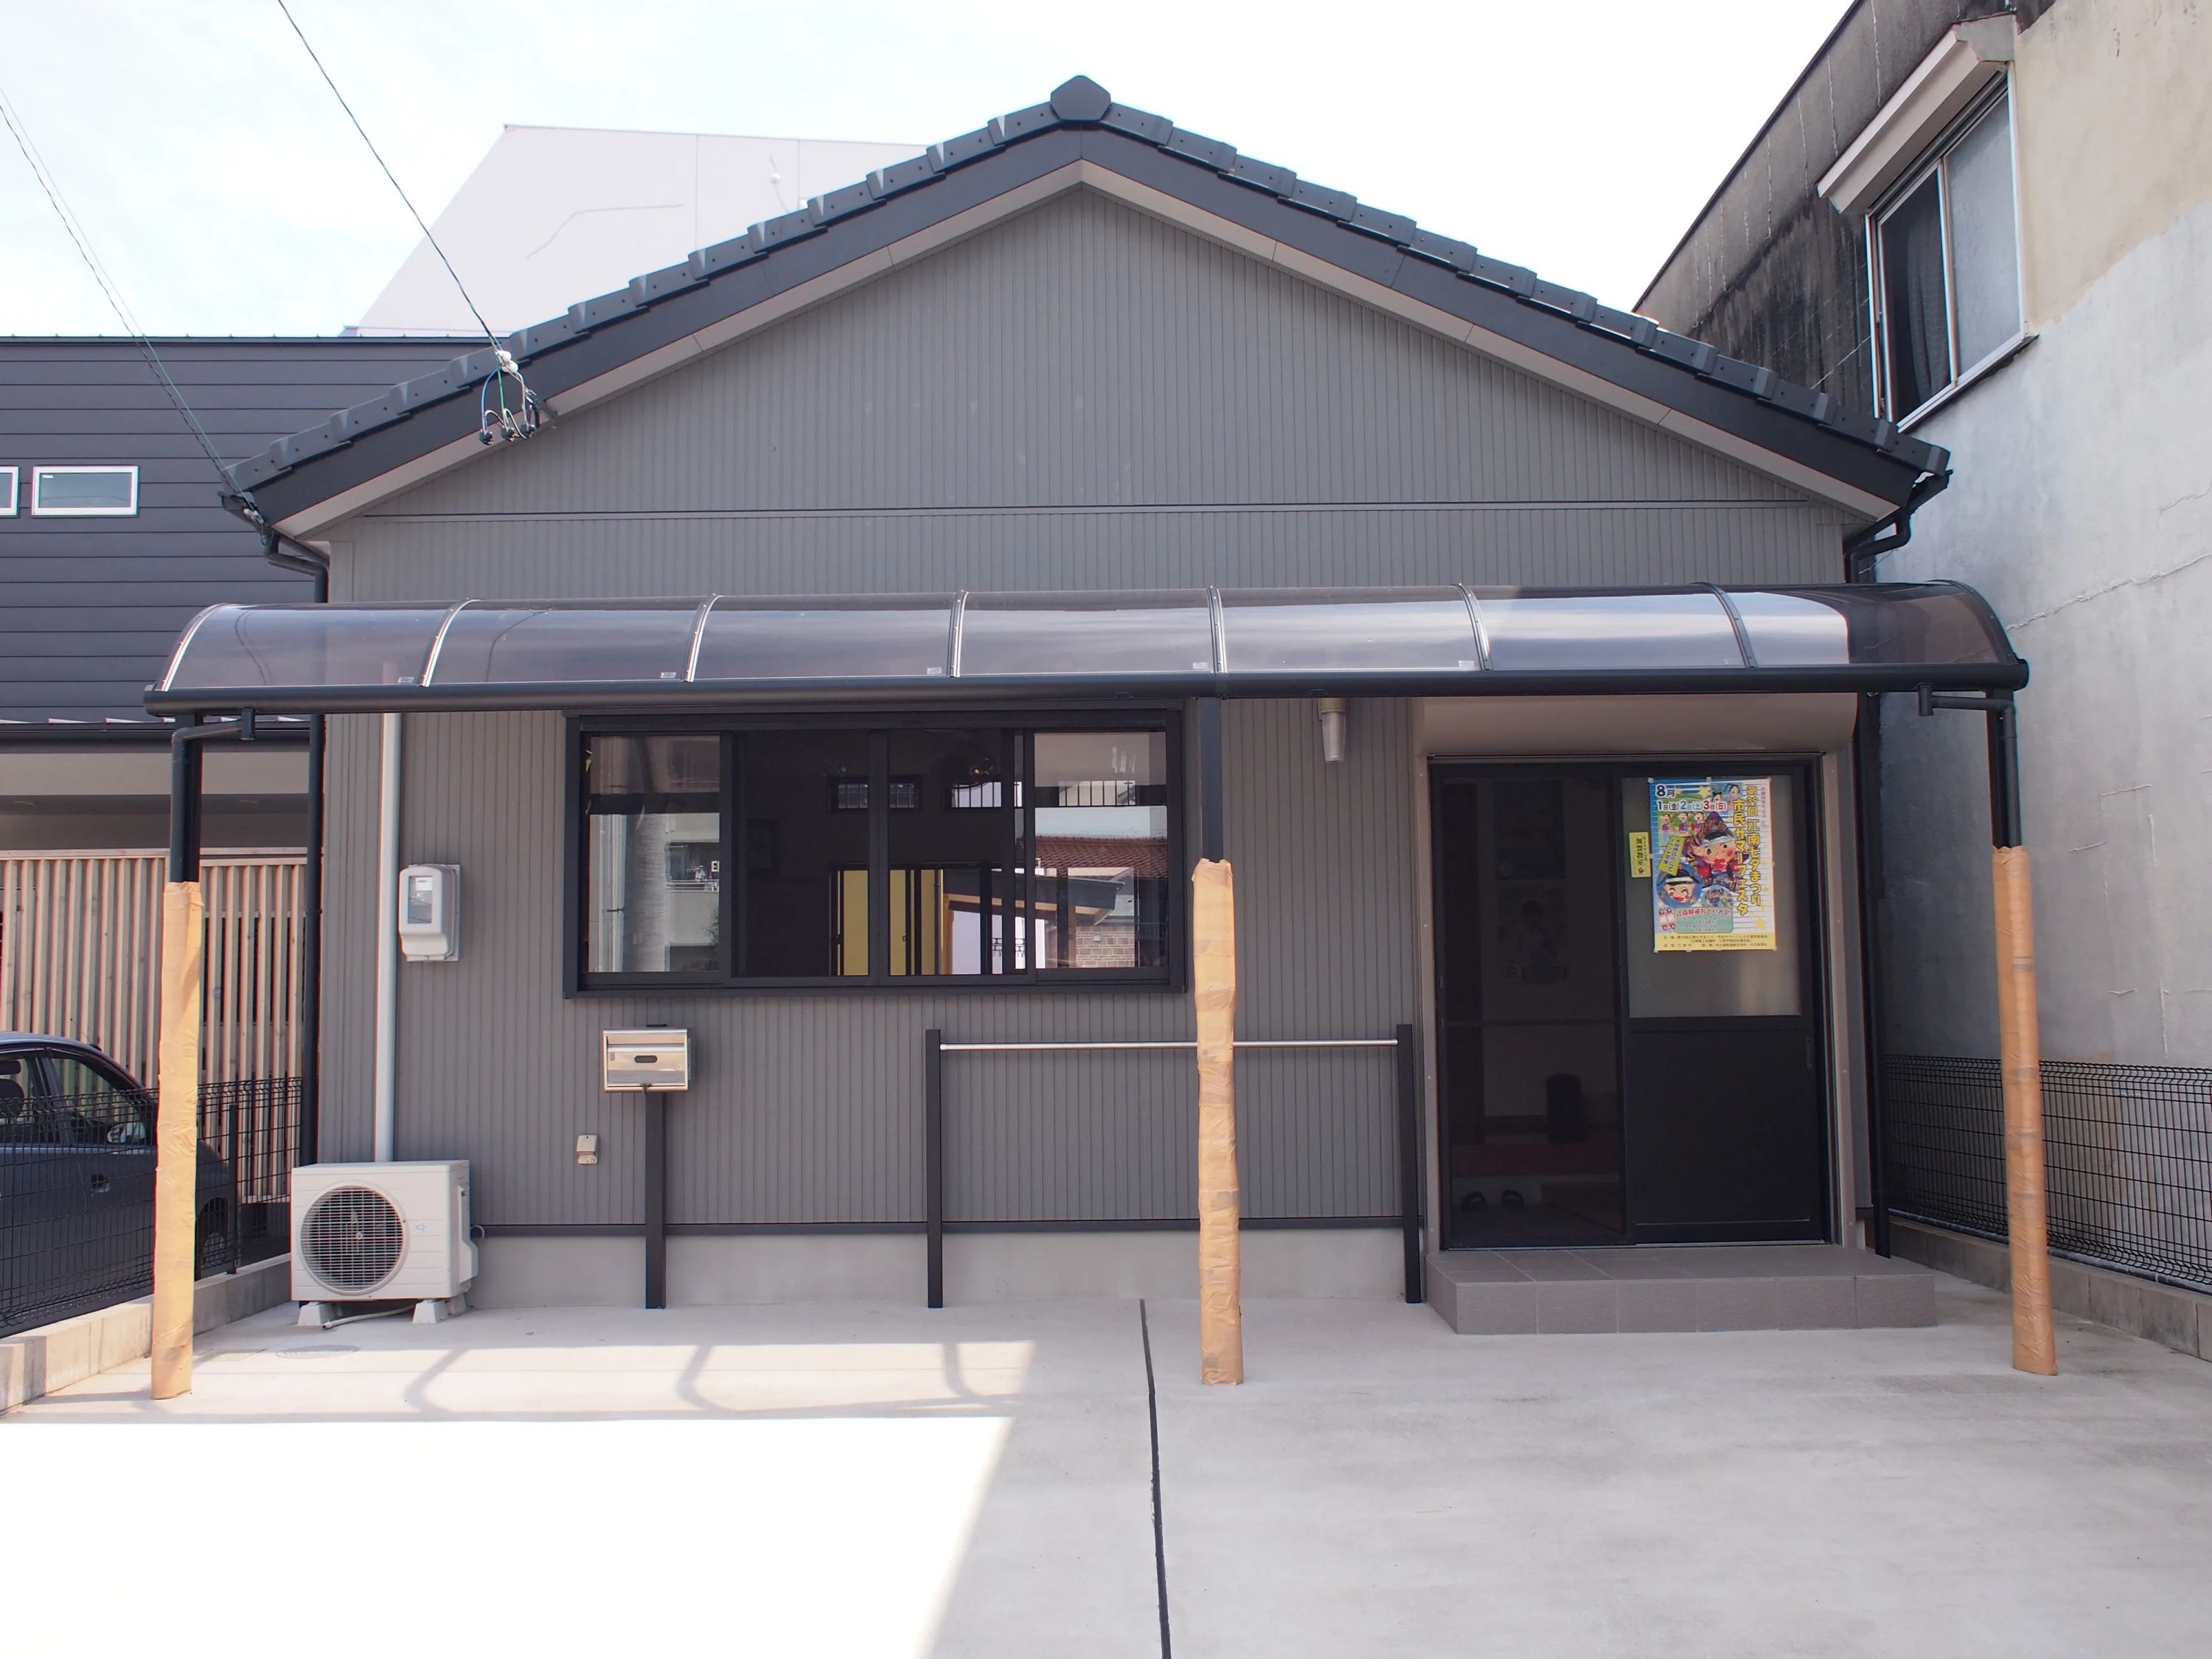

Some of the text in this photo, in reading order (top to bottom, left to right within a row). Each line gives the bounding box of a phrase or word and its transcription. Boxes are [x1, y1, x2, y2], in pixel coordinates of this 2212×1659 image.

[1656, 785, 1676, 798] 8月
[1733, 799, 1748, 916] 市民サマーフェスタ
